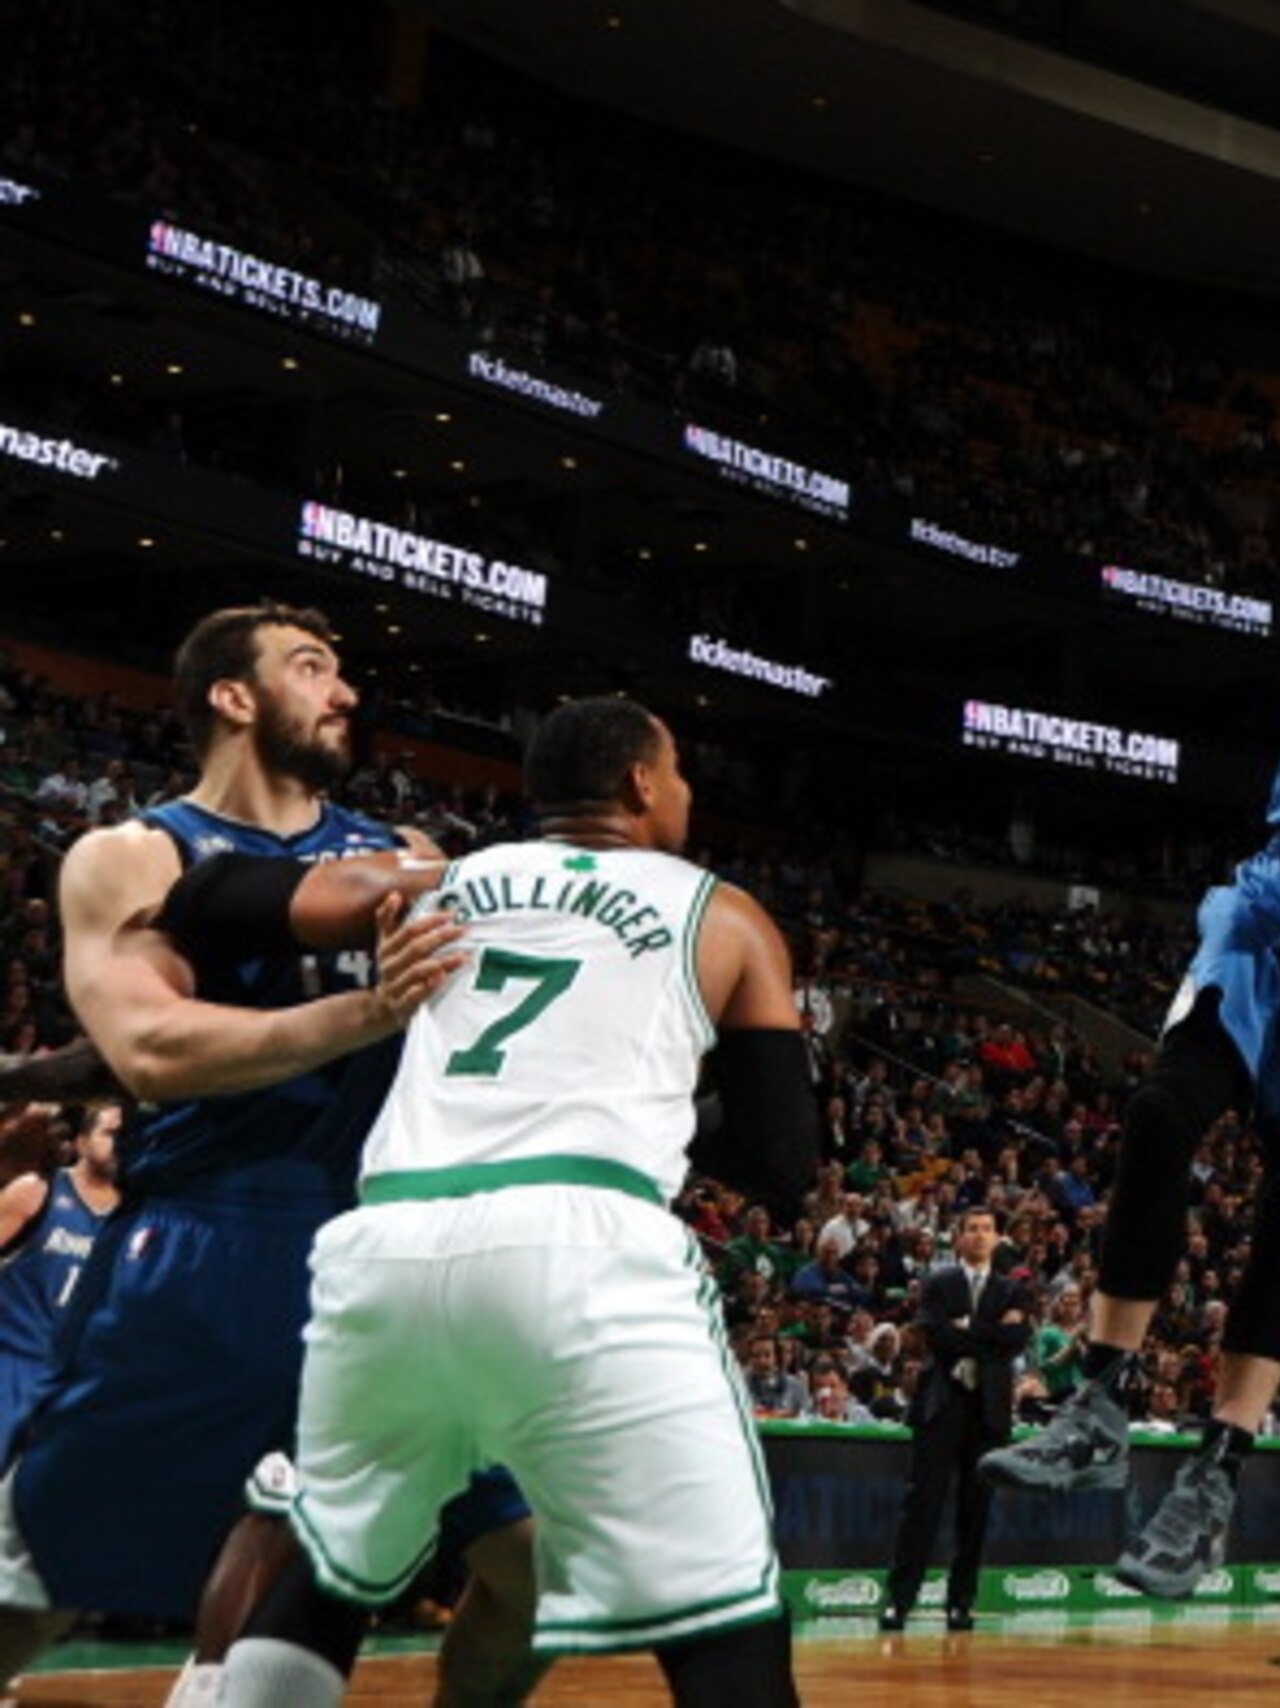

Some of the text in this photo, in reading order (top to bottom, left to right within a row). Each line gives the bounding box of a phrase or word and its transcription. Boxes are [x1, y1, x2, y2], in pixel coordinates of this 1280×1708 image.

[162, 222, 381, 332] NBATICKETS.COM
[468, 351, 603, 417] ticketmaster
[315, 505, 547, 607] NBATICKETS.COM
[689, 633, 827, 698] ticketmaster
[976, 703, 1180, 769] NBATICKETS.COM
[439, 876, 674, 960] SULLINGER
[443, 946, 584, 1078] 7
